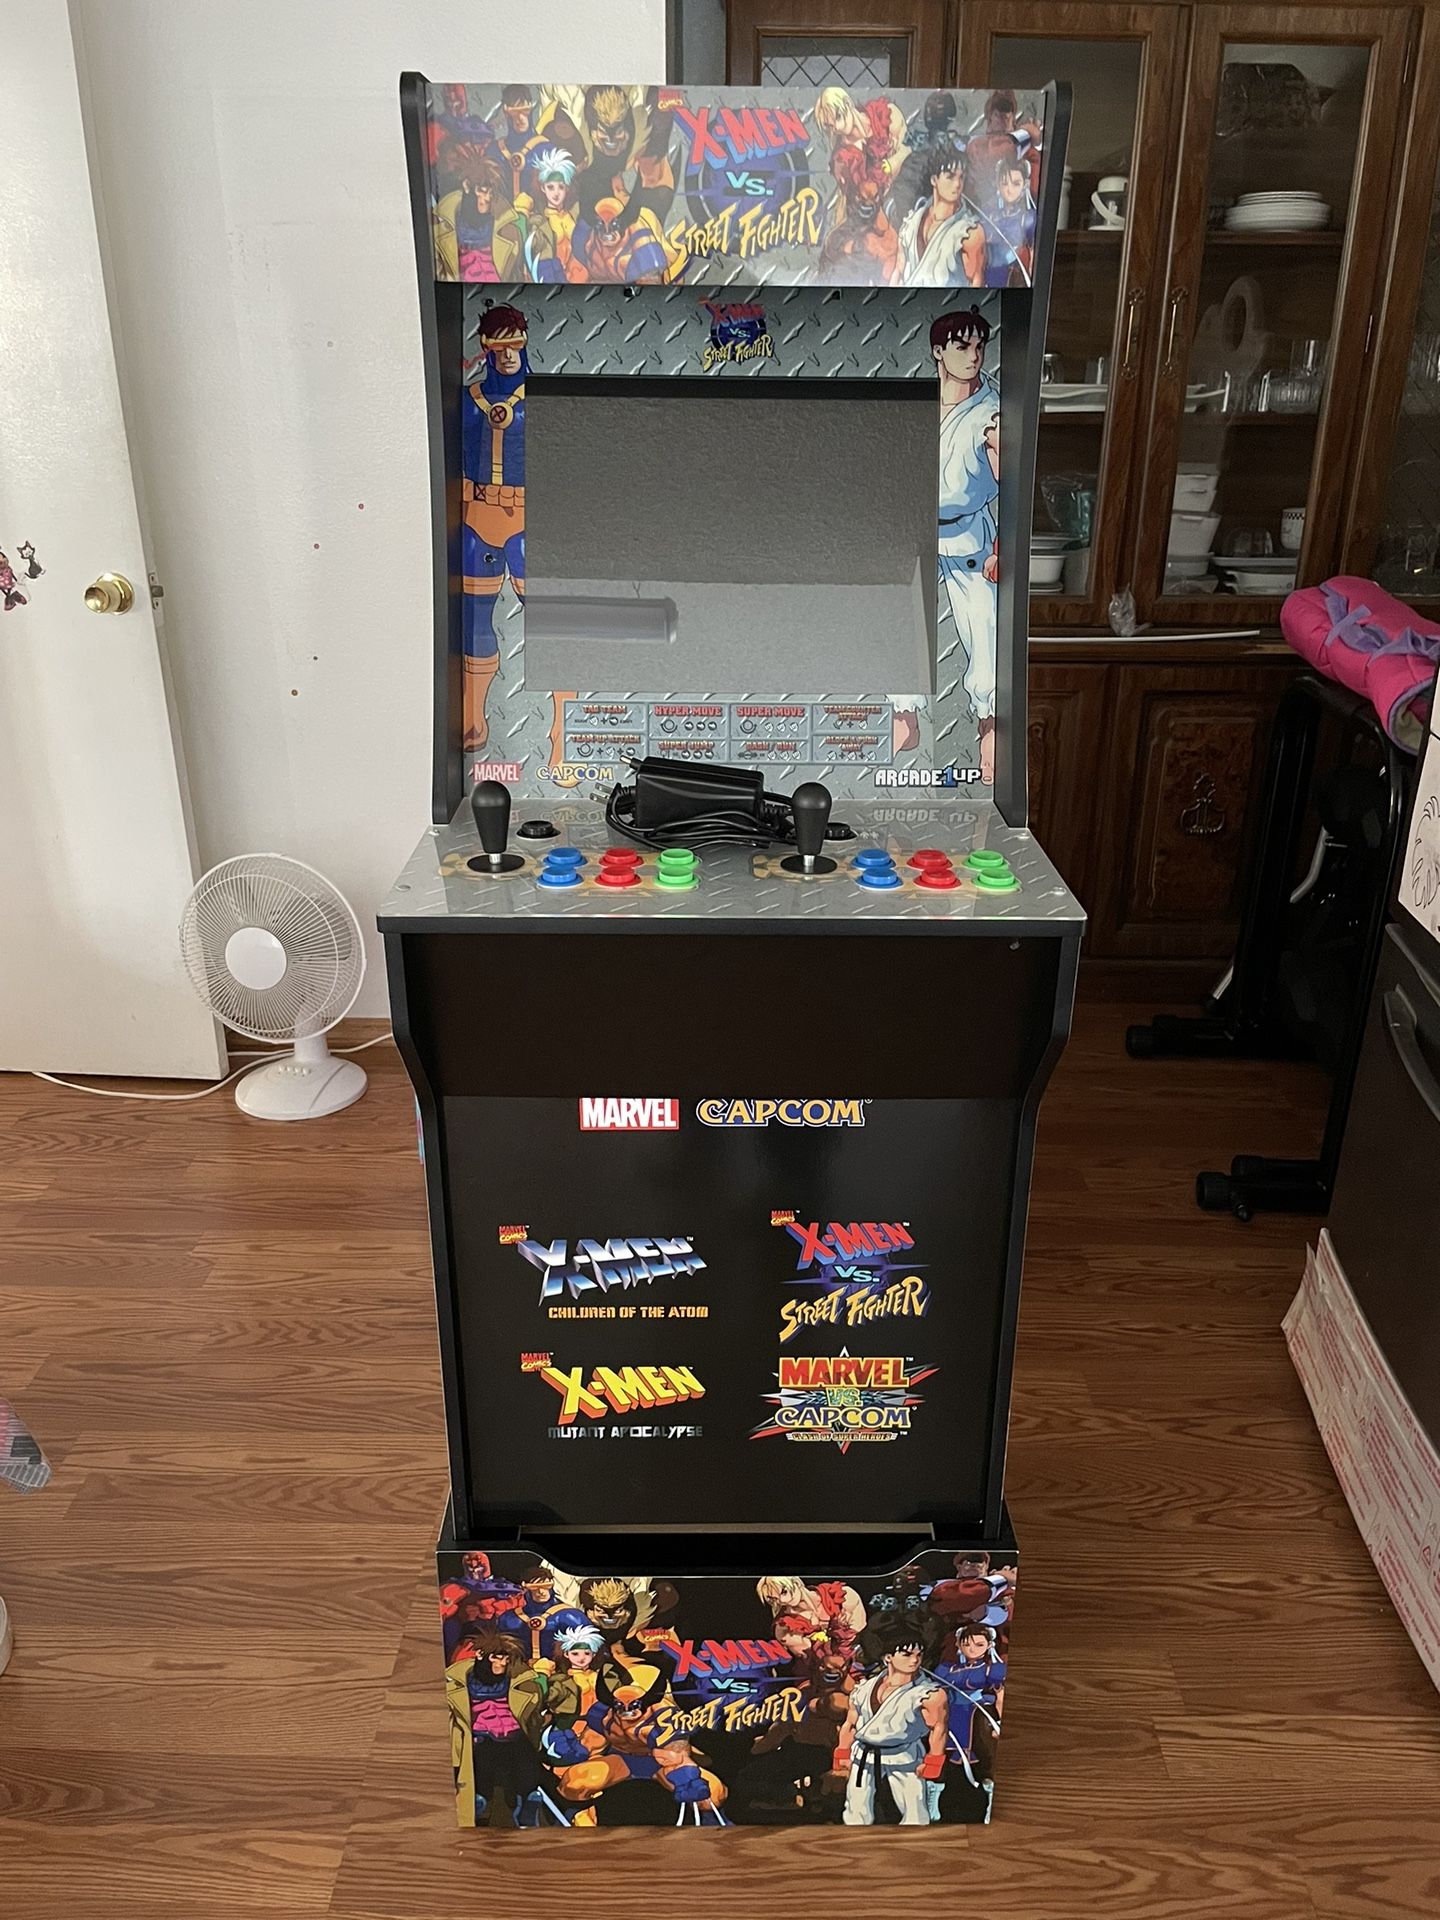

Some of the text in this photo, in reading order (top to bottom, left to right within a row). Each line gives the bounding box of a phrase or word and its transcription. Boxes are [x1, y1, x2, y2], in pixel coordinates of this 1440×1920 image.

[673, 107, 811, 172] X-MEN
[664, 187, 822, 285] STREET FIGHTER
[703, 334, 774, 373] STREET FIGHTER
[655, 705, 723, 717] HYPER MOVE
[736, 706, 805, 718] SUPER MOVE
[658, 740, 689, 751] SUPER
[474, 764, 519, 781] MARVEL
[536, 765, 615, 781] CAPCOM
[582, 1097, 677, 1127] MARVEL
[696, 1098, 866, 1127] CAPCOM
[786, 1222, 916, 1271] X-MEN
[548, 1306, 709, 1319] CHILDREN OF THE ATOM
[779, 1276, 932, 1344] STREET FIGHTER
[779, 1357, 911, 1388] MARVEL
[540, 1366, 707, 1425] X-MEN
[548, 1426, 703, 1439] MUTANT APOCALYPSE
[774, 1406, 911, 1429] CAPCOM
[660, 1640, 793, 1682] X-MEN
[656, 1687, 807, 1746] STREET FIGHTER
